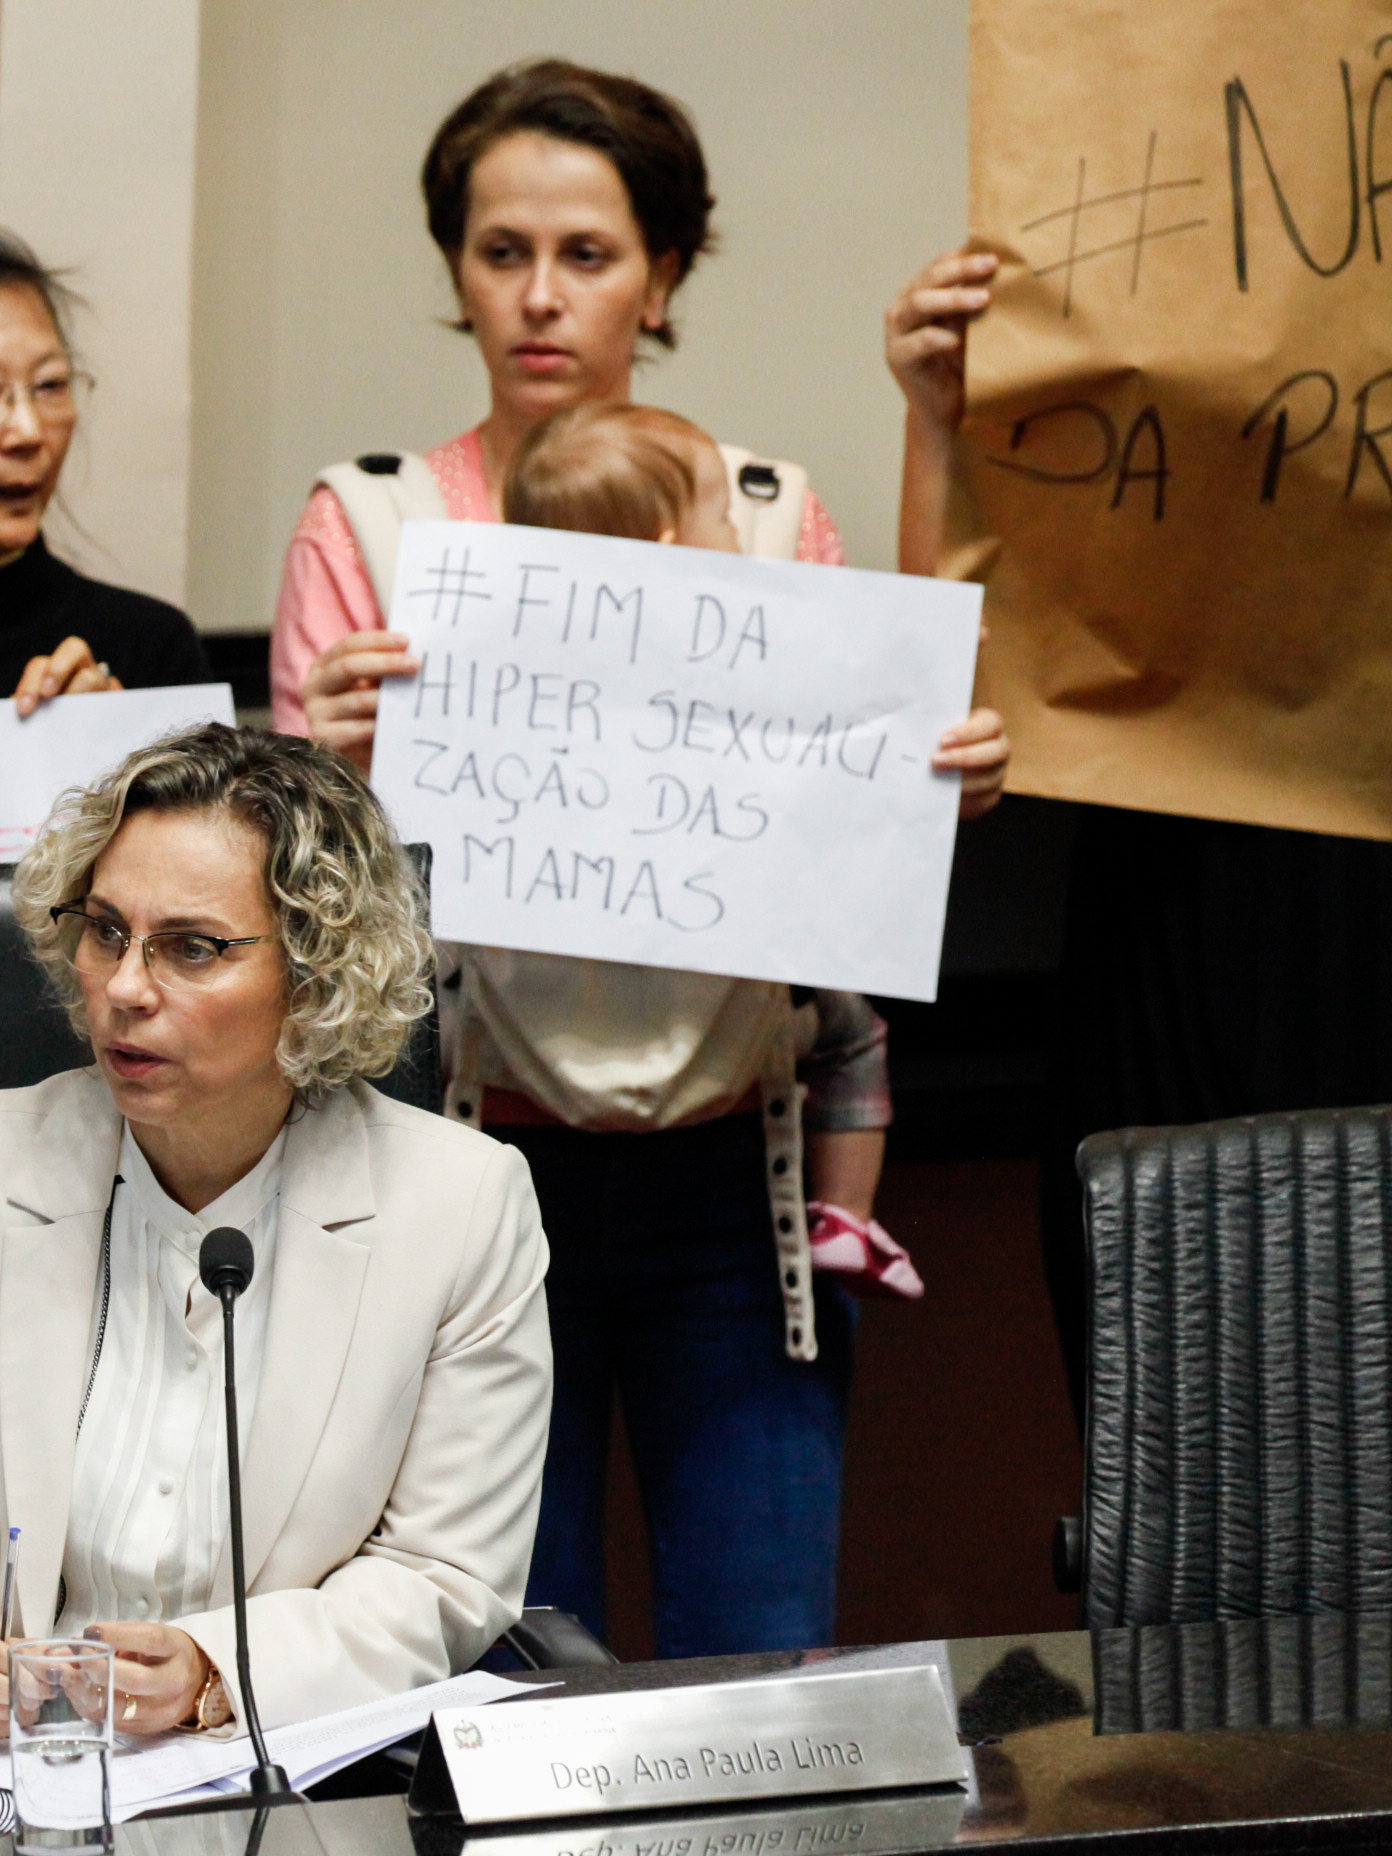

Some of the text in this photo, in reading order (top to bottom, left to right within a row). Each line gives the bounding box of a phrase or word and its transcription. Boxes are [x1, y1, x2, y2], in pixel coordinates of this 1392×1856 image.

[986, 401, 1172, 522] DA
[407, 546, 768, 669] #FIM DA
[412, 651, 602, 741] HIPER
[413, 738, 769, 842] ZAÇÃO DAS
[462, 833, 725, 933] MAMAS
[549, 1737, 865, 1796] Dep. Ana Paula Lima
